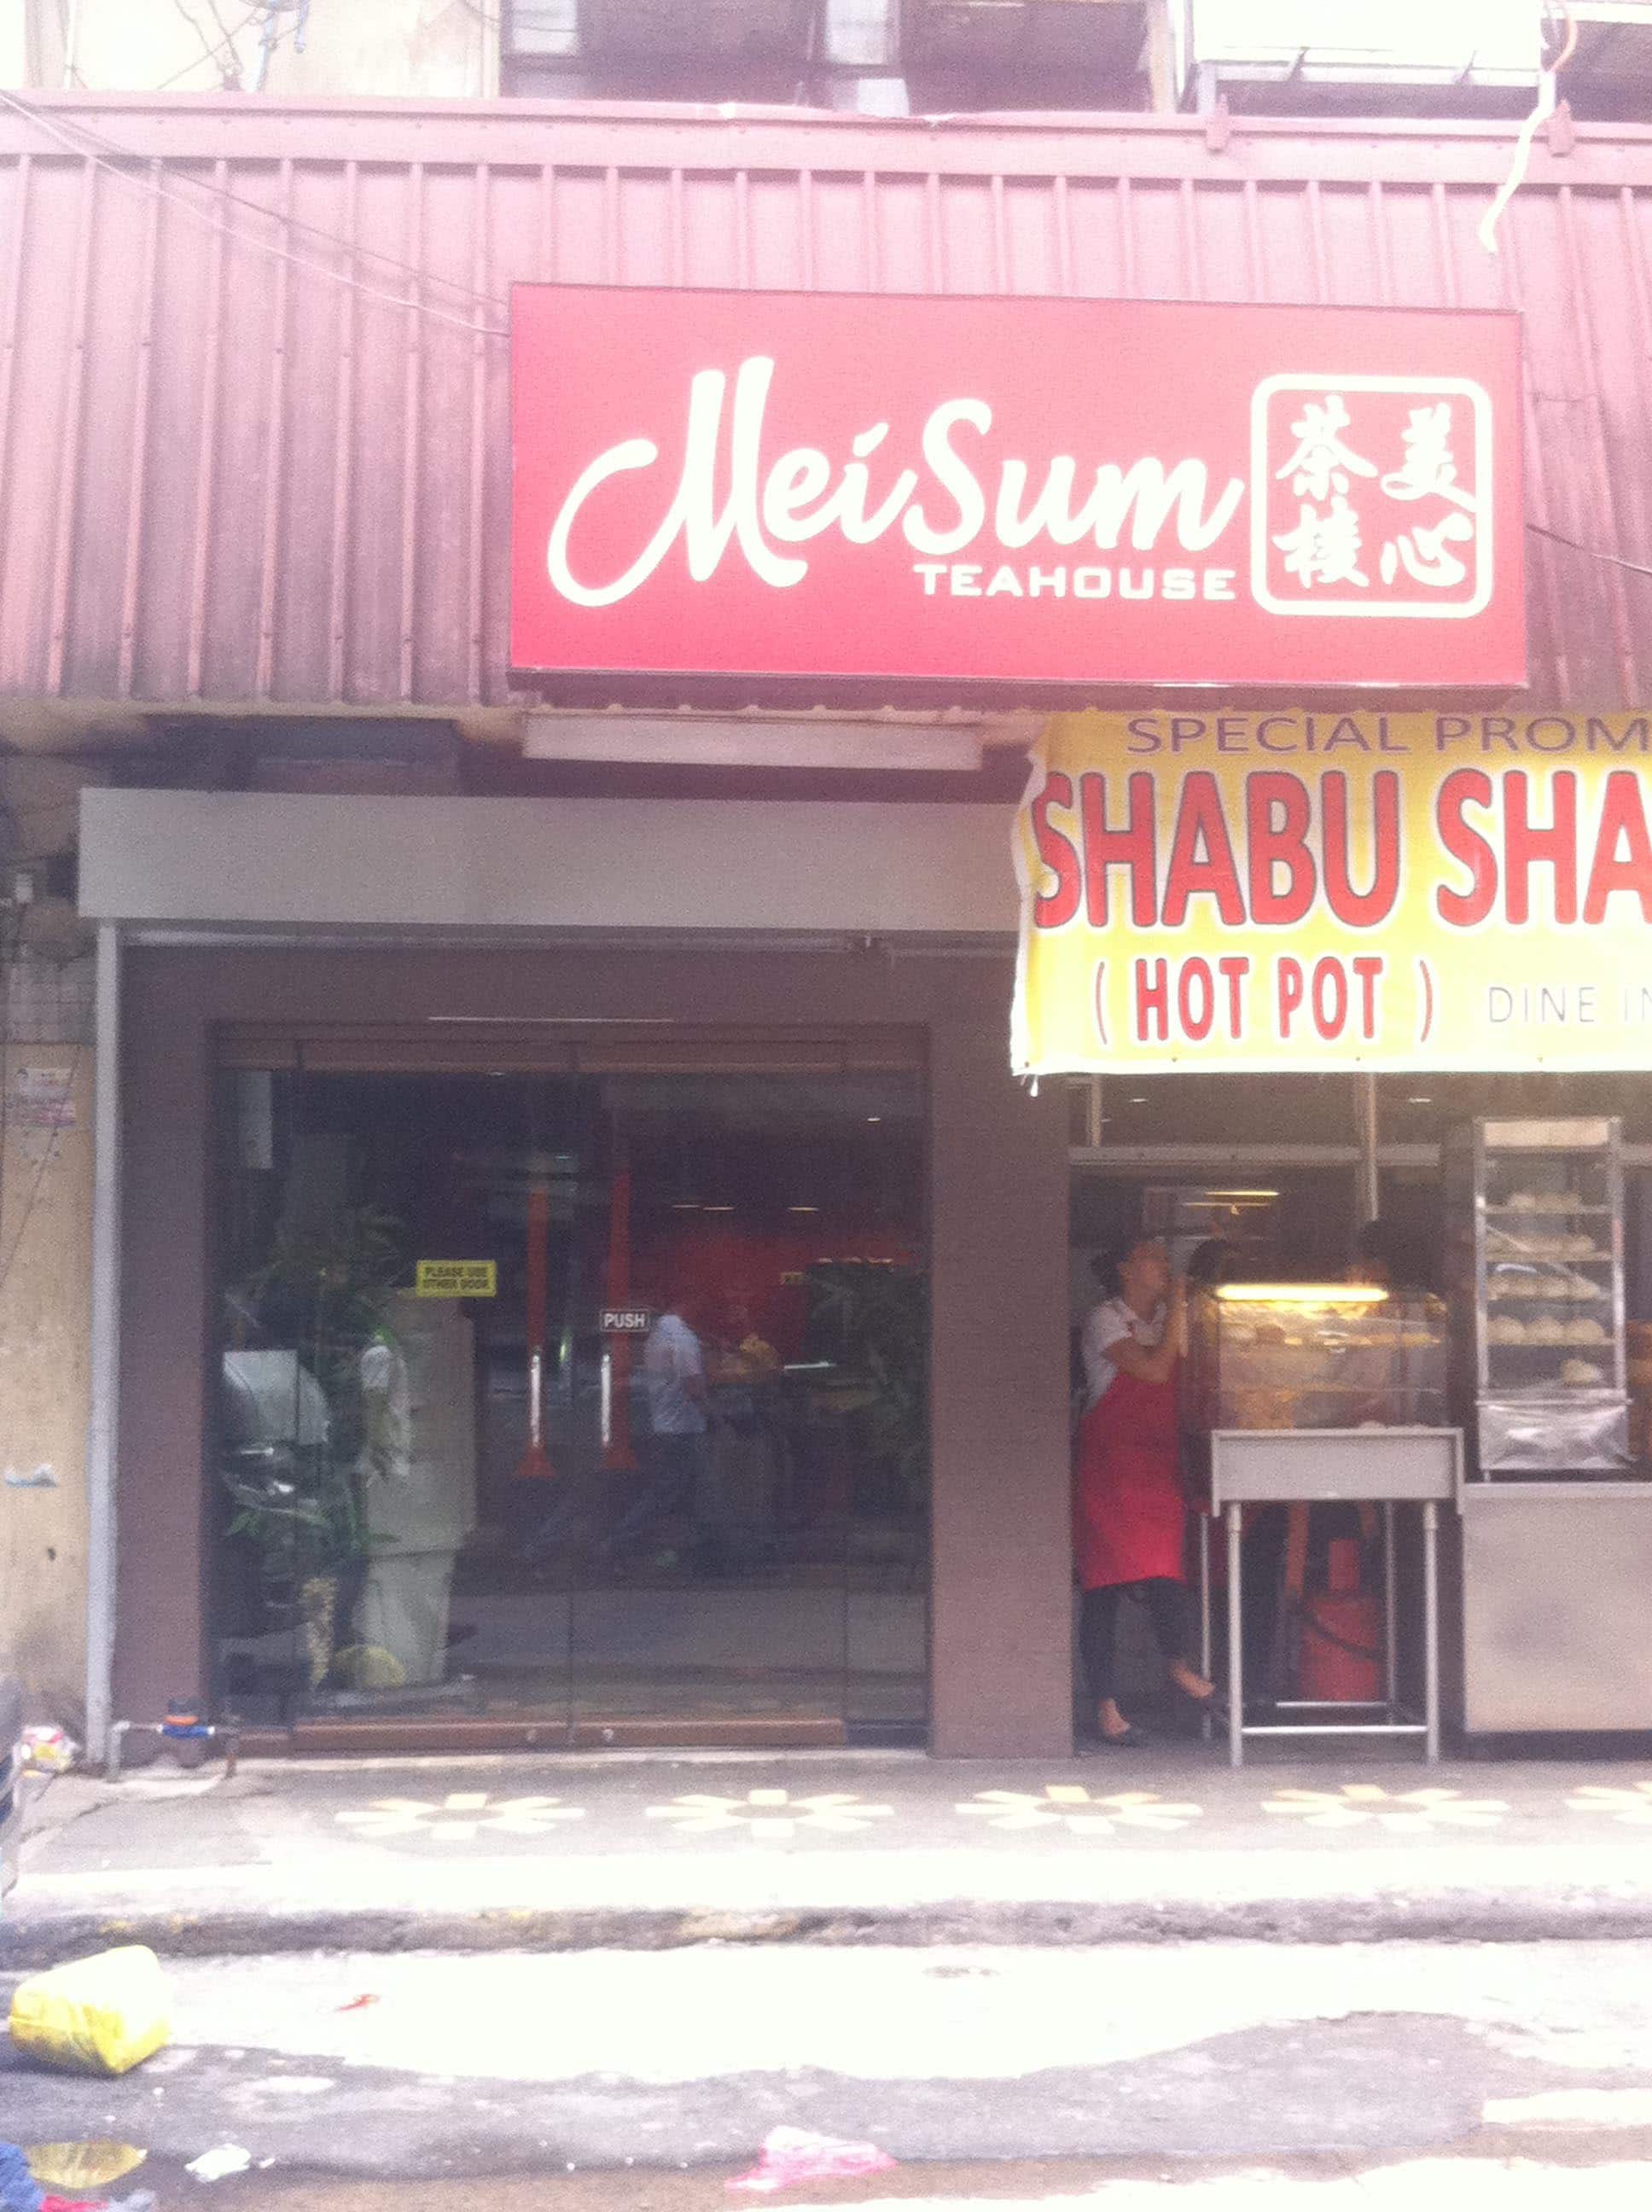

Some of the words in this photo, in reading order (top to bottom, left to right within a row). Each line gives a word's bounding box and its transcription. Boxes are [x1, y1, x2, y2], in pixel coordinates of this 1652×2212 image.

[913, 562, 1237, 602] TEAHOUSE
[1127, 716, 1410, 754] SPECIAL
[1435, 717, 1649, 754] PROM
[1032, 771, 1400, 928] SHABU
[1436, 768, 1652, 927] SHA
[1489, 987, 1597, 1022] DINE
[605, 1313, 645, 1328] PUSH
